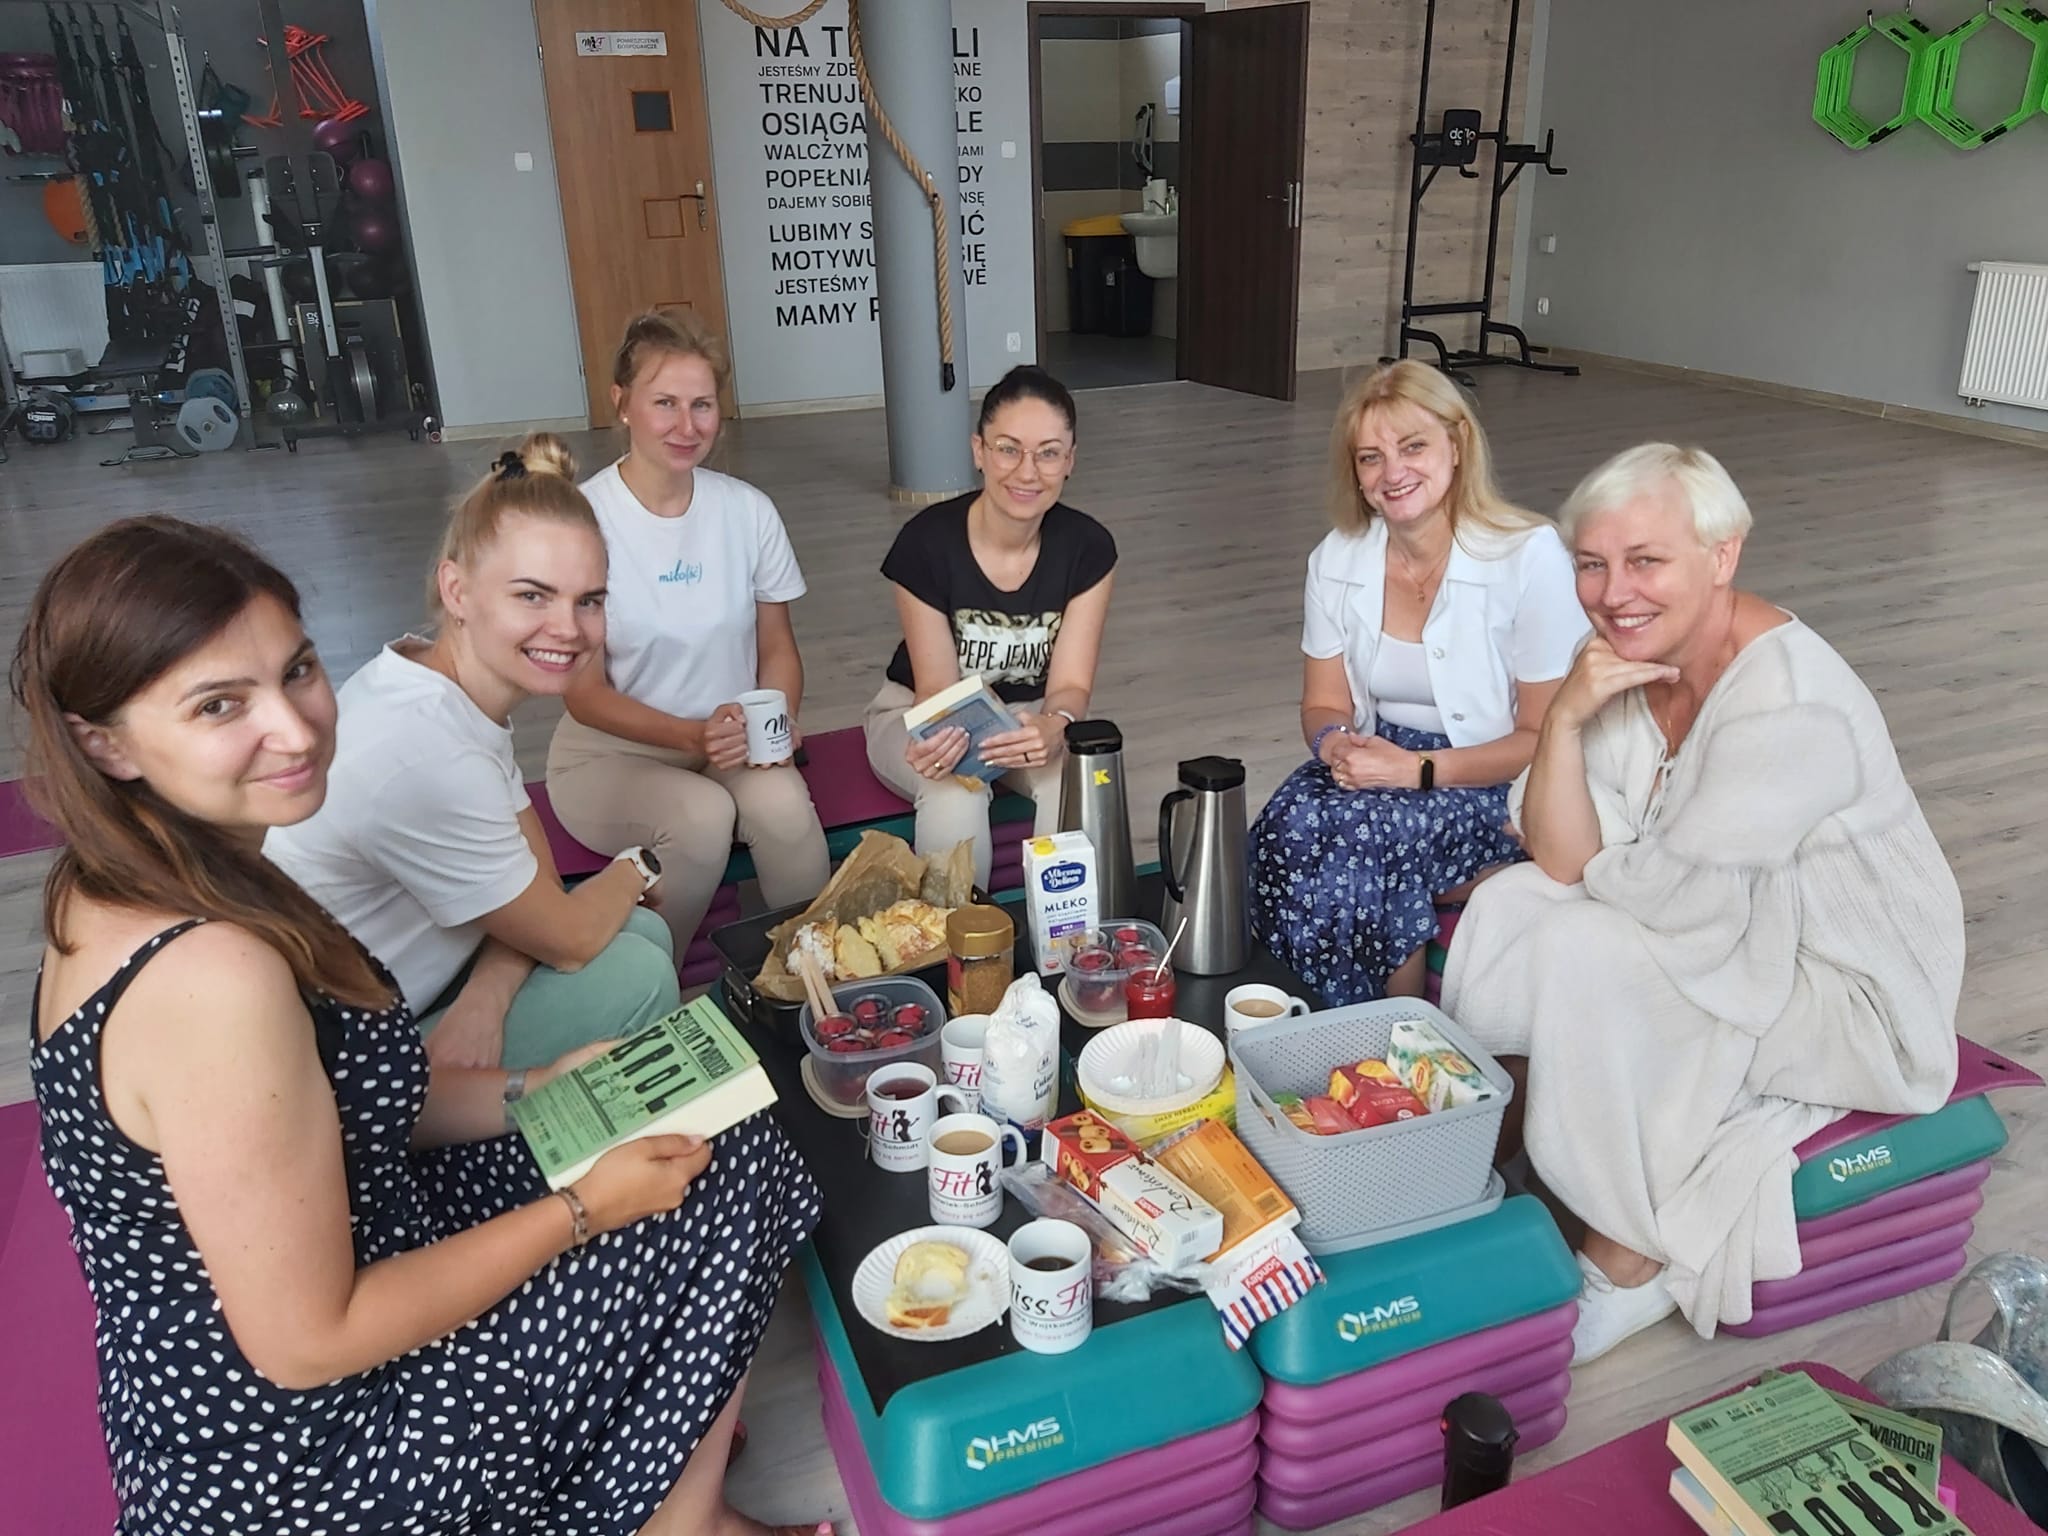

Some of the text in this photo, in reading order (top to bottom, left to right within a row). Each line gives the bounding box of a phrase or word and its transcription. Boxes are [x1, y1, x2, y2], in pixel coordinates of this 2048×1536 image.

[755, 26, 809, 57] NA
[758, 63, 820, 77] JESTEŚMY
[759, 84, 865, 103] TRENUJ
[762, 111, 867, 142] OSIĄGA
[766, 168, 870, 188] POPEŁNIA
[768, 196, 827, 210] DAJEMY
[769, 222, 852, 242] LUBIMY
[771, 248, 877, 271] MOTYWU
[775, 274, 869, 295] JESTEŚMY
[777, 302, 857, 327] MAMY
[958, 639, 1049, 671] PEPE JEANS
[1044, 897, 1088, 913] MLEKO
[608, 1024, 697, 1114] KRÓL
[1847, 1145, 1890, 1169] HMS
[933, 1167, 974, 1196] Fit
[1244, 1257, 1283, 1290] Sondey
[1360, 1295, 1420, 1326] HMS
[990, 1416, 1061, 1452] HMS
[996, 1432, 1065, 1462] PREMIUM
